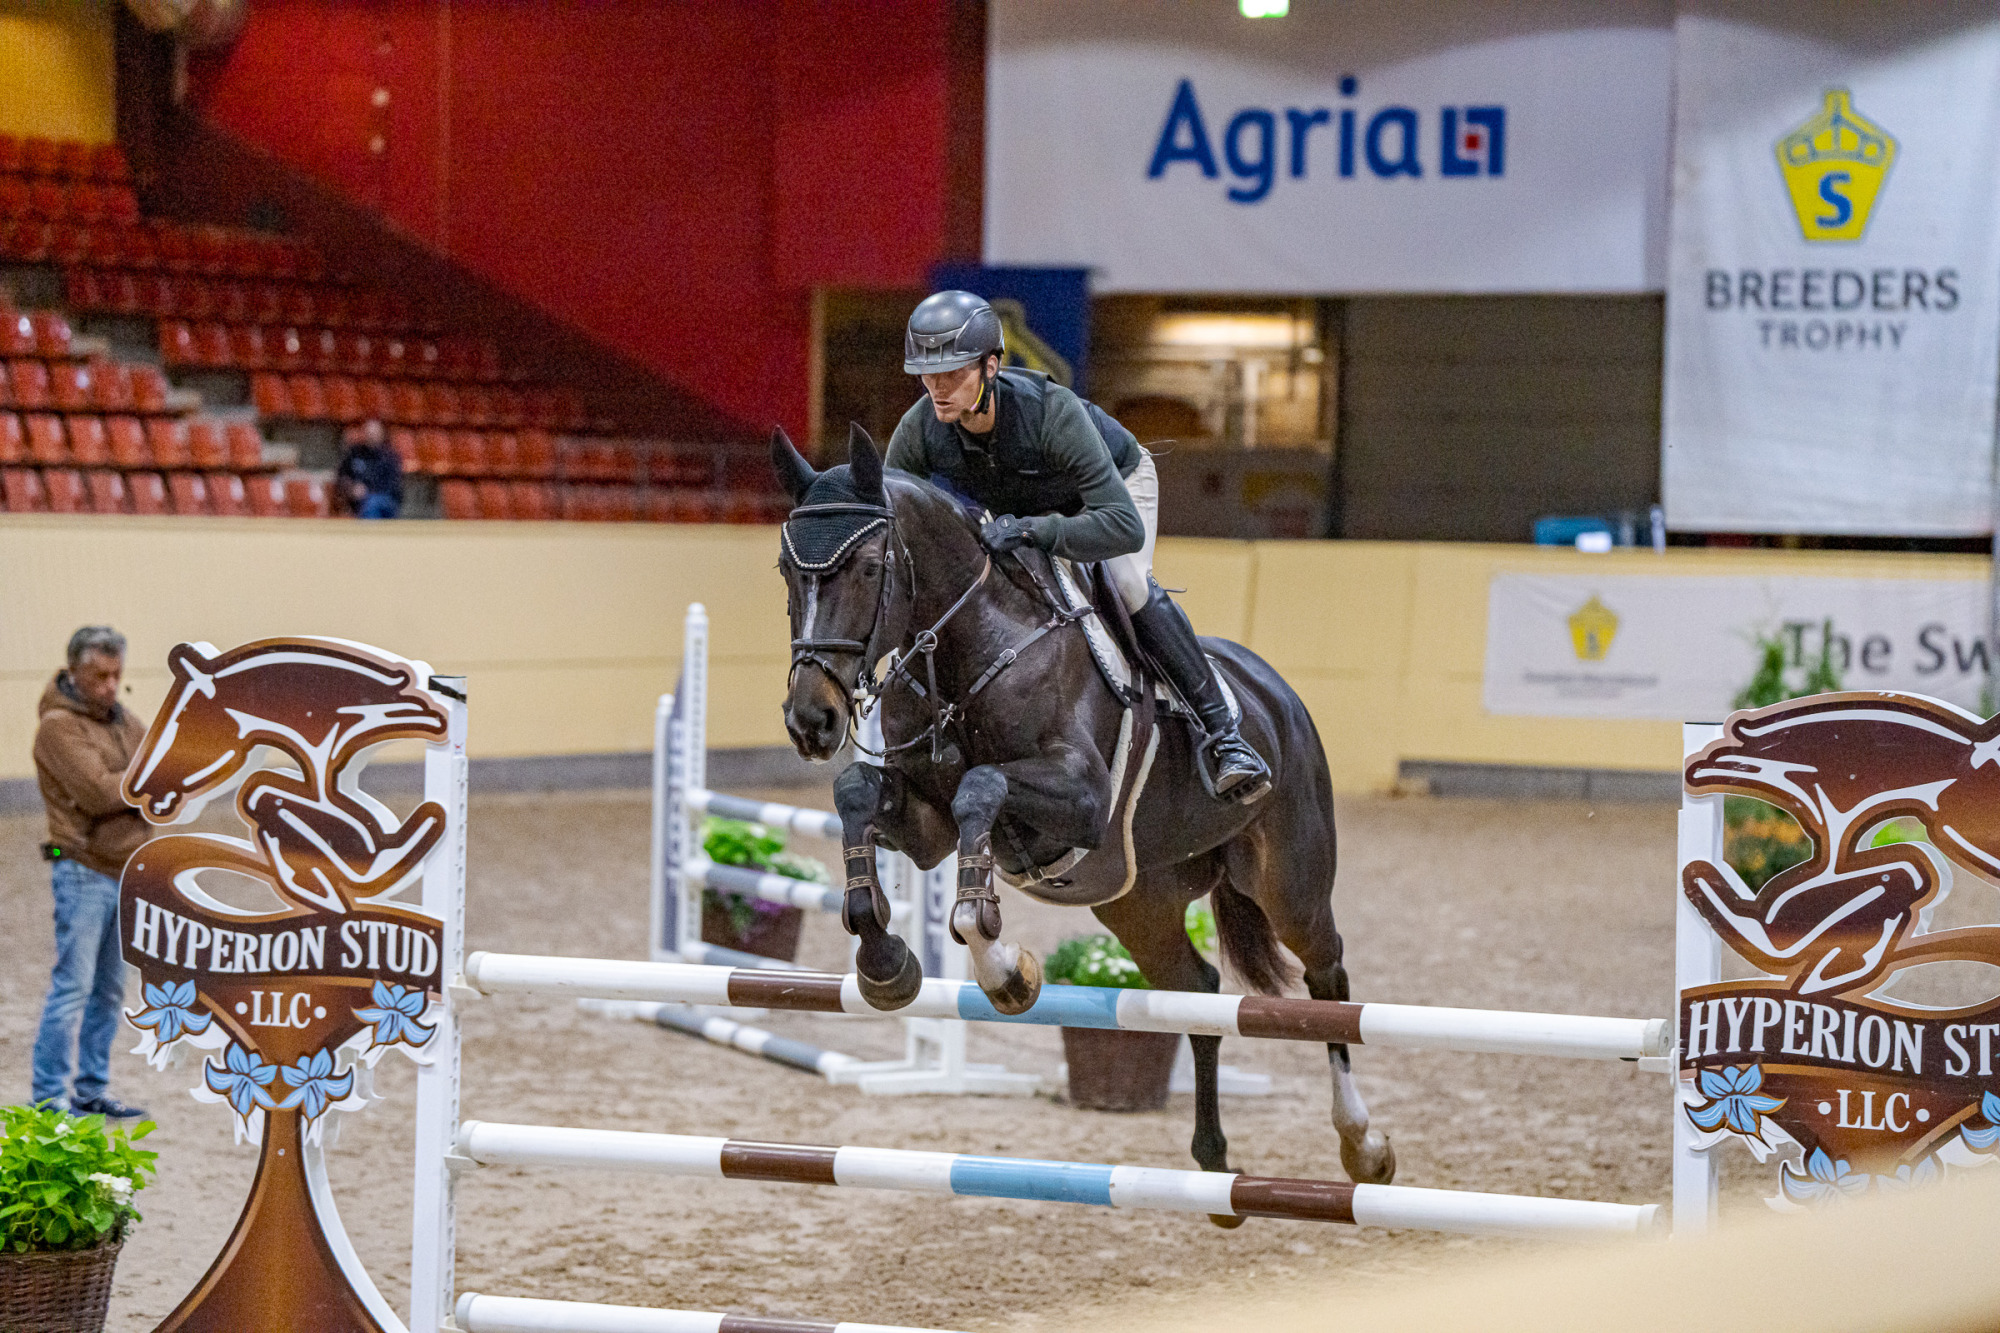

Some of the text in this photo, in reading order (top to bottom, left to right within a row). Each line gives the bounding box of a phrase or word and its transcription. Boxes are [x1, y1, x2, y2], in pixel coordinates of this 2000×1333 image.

[1147, 75, 1422, 204] Agria
[1815, 170, 1853, 229] S
[1705, 267, 1960, 312] BREEDERS
[1757, 319, 1908, 349] TROPHY
[1782, 617, 1891, 674] The
[131, 897, 439, 977] HYPERION STUD
[250, 990, 311, 1029] LLC
[1686, 996, 2000, 1076] HYPERION ST
[1836, 1089, 1911, 1133] LLC
